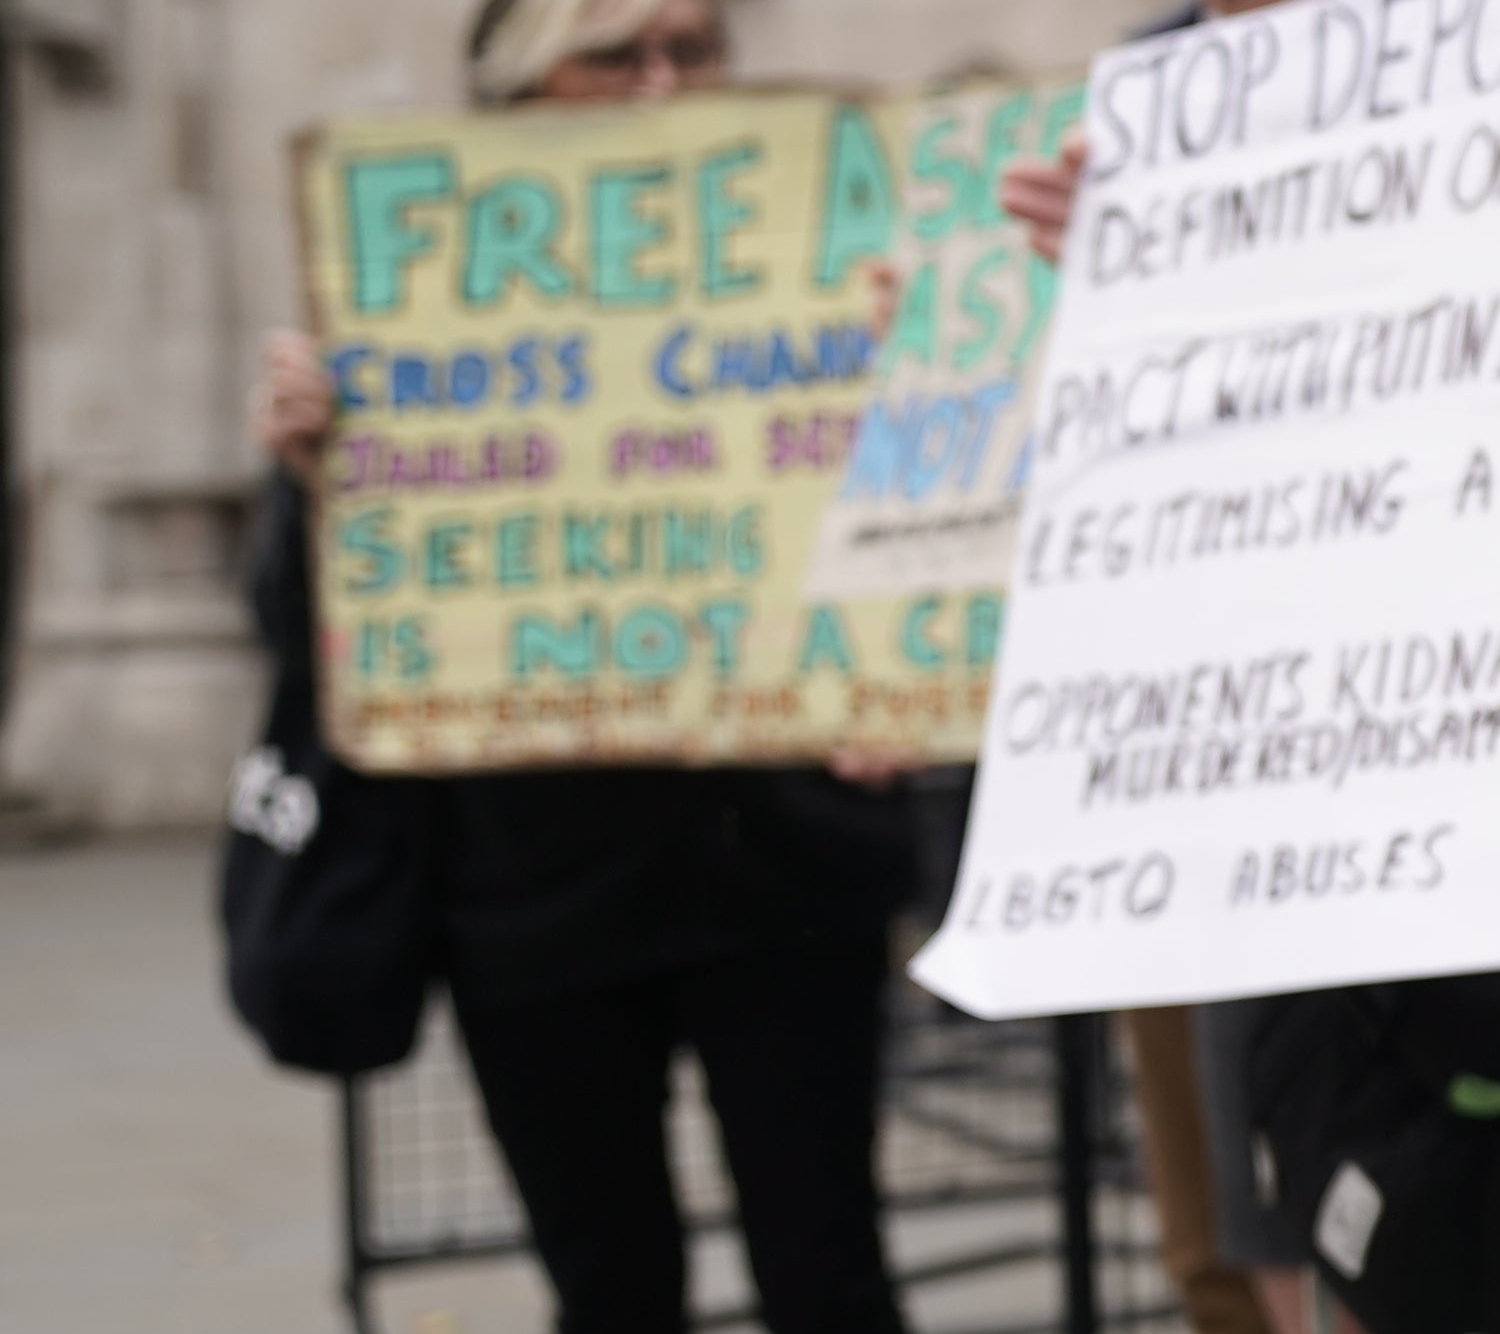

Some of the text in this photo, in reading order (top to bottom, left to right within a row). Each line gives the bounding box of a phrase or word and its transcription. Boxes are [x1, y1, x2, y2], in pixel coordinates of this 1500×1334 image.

[1091, 27, 1284, 183] STOP
[342, 149, 764, 313] FREE
[1088, 142, 1430, 289] DEFINITION
[328, 331, 596, 417] CROSS
[1044, 335, 1206, 457] PACT
[608, 428, 718, 478] FOR
[336, 501, 768, 599] SEEKING
[1023, 463, 1412, 589] LEGITIMISING
[1454, 447, 1495, 517] A
[350, 619, 438, 685] IS
[508, 597, 752, 683] NOT
[802, 593, 858, 675] A
[1003, 649, 1312, 759] OPPONENTS
[1226, 823, 1458, 911] ABUSES
